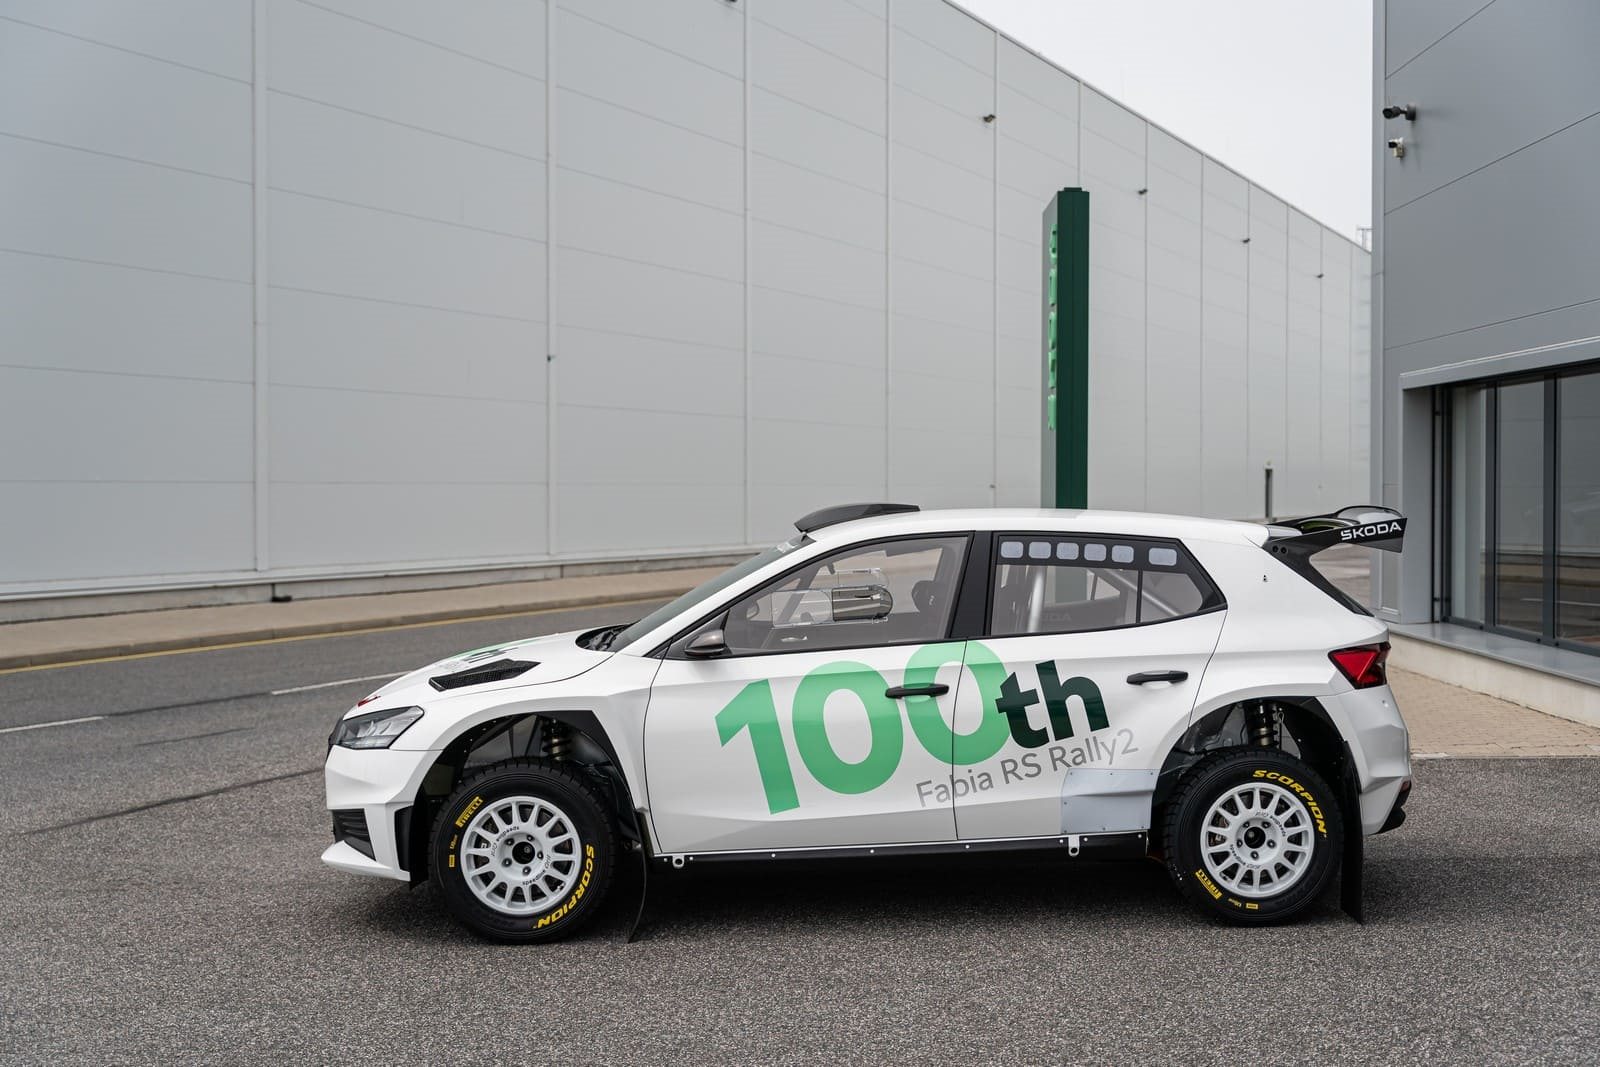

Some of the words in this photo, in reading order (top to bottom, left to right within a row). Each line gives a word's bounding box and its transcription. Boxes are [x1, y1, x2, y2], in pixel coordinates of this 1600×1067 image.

[915, 768, 994, 808] Fabia
[1000, 752, 1042, 785] RS
[1048, 728, 1139, 772] Rally2
[1253, 769, 1327, 834] SCORPION
[454, 795, 484, 829] PIRELLI
[536, 843, 595, 929] SCORPION
